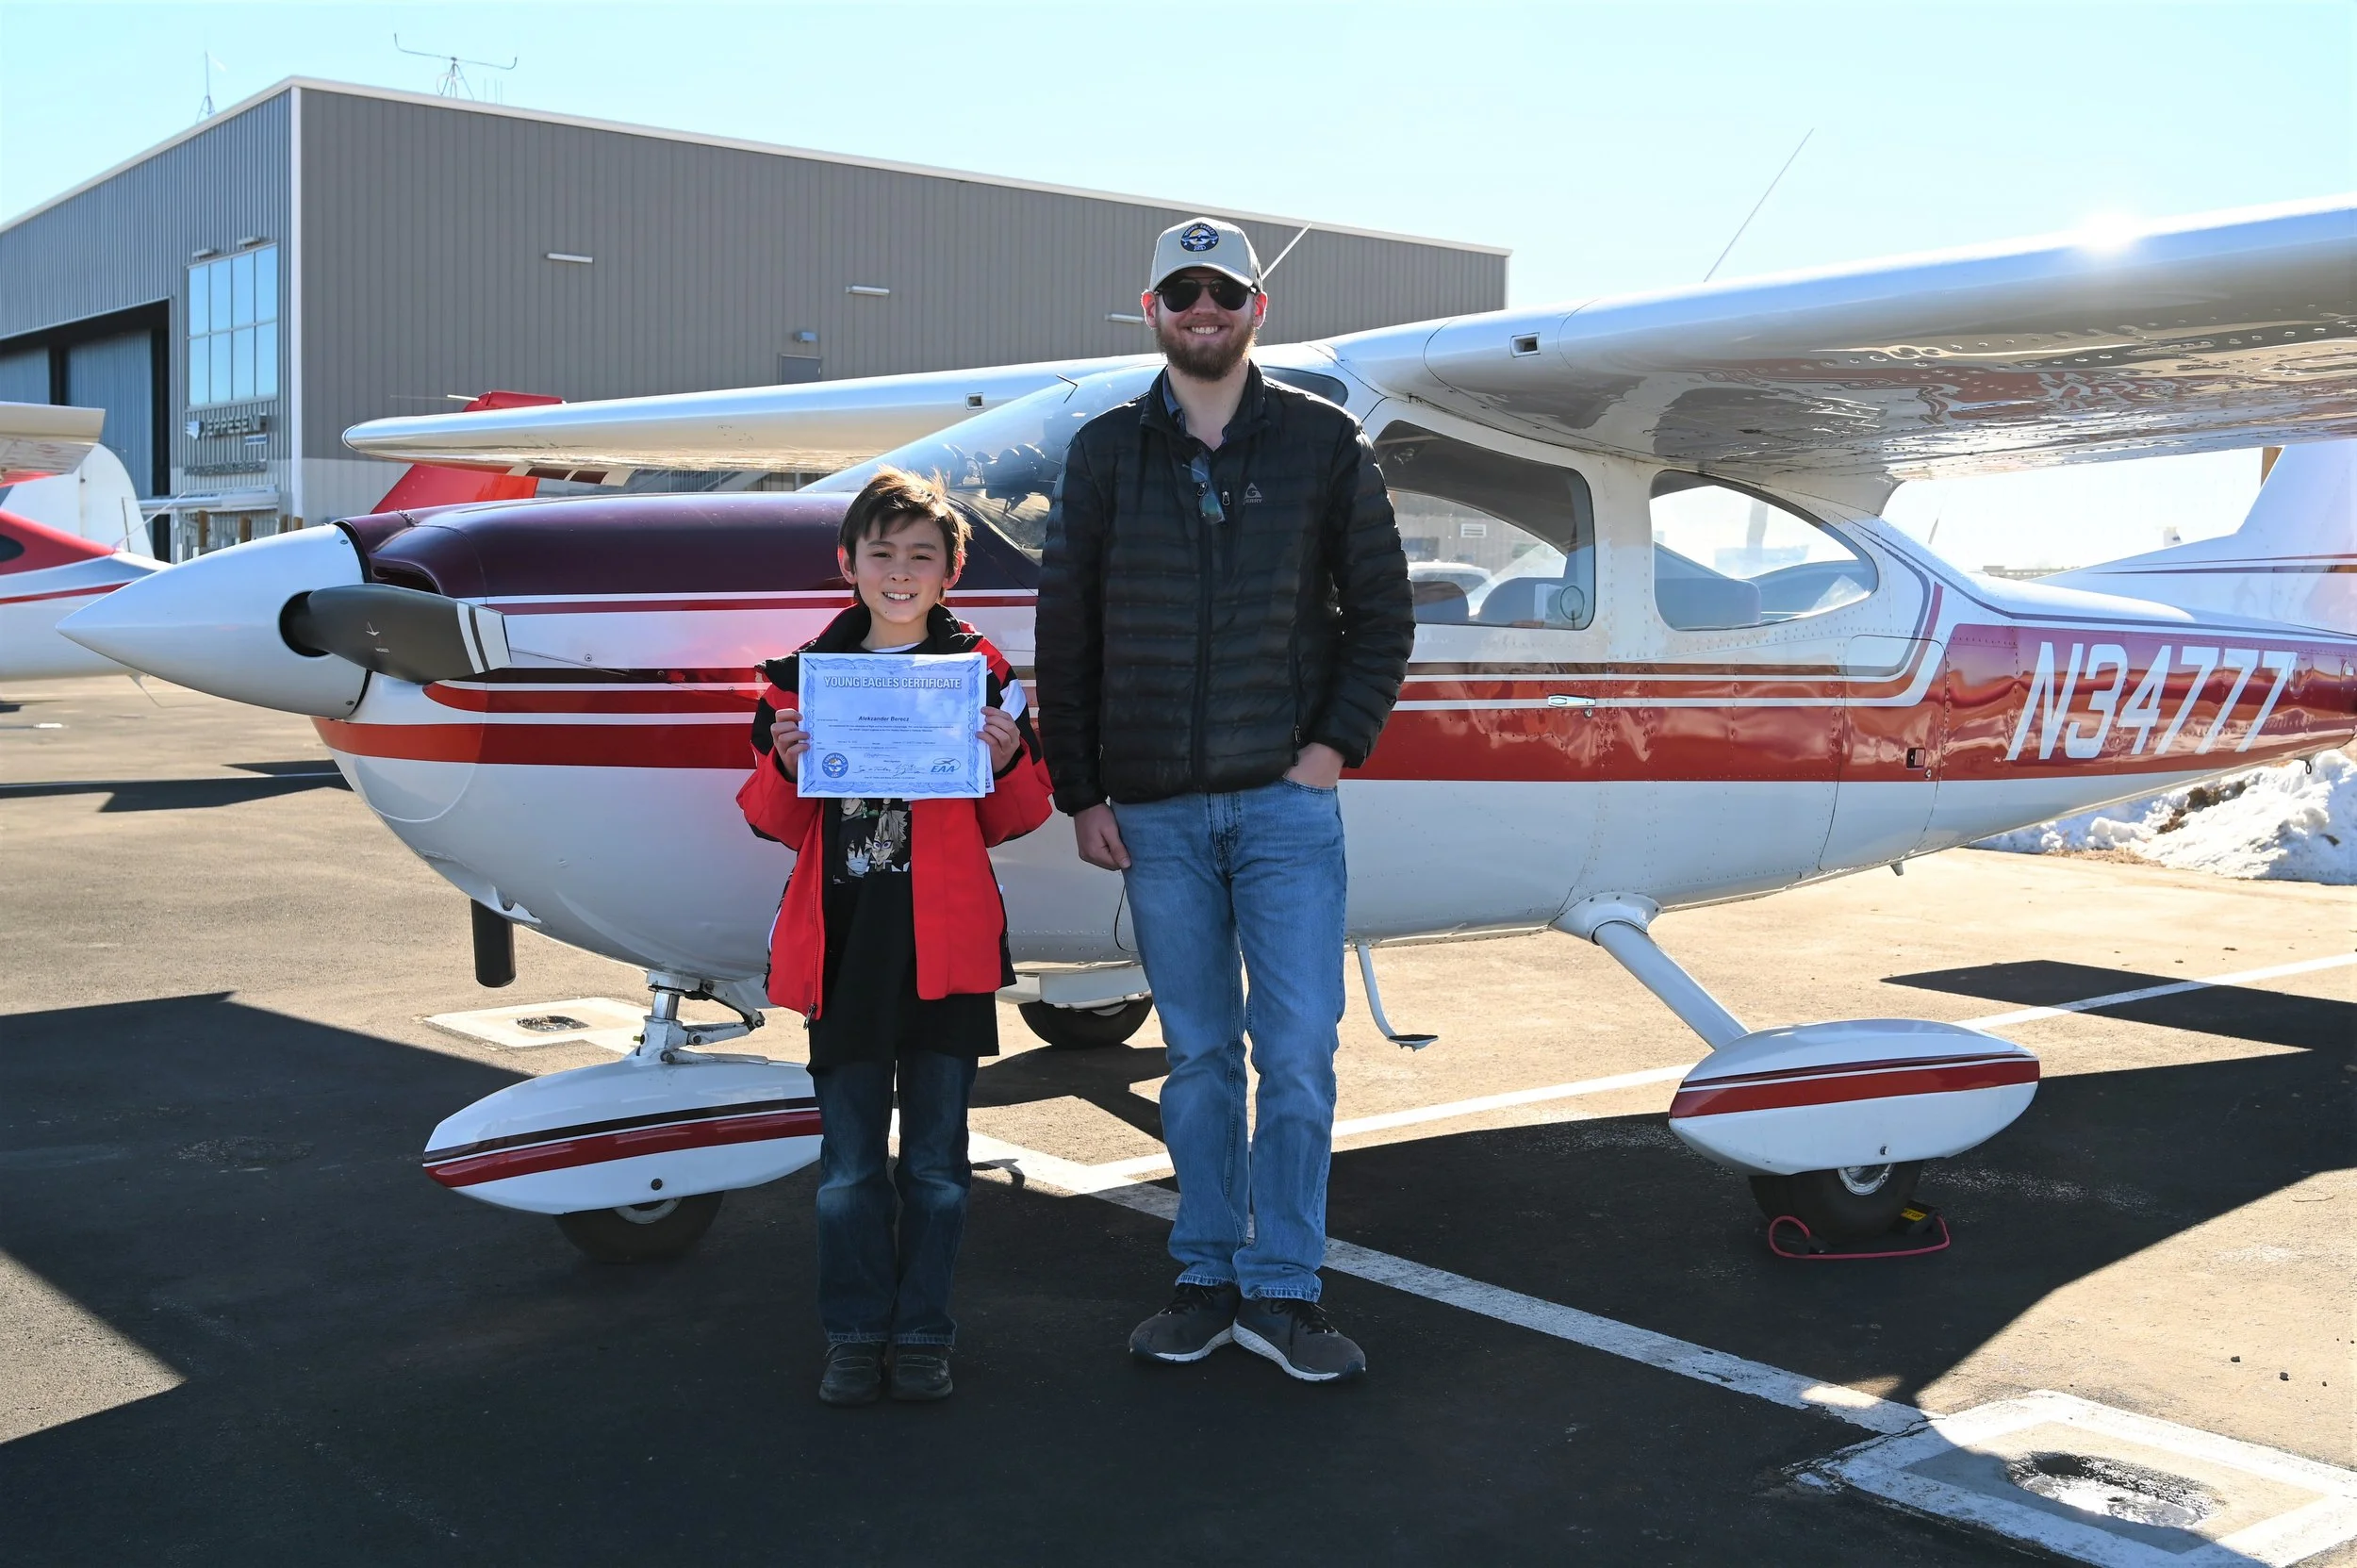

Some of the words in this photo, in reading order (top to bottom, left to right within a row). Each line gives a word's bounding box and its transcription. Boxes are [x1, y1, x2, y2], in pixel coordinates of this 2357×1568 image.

[824, 676, 860, 688] YOUNG
[862, 676, 899, 688] EAGLES
[901, 677, 962, 689] CERTIFICATE
[2004, 641, 2298, 761] N34777
[930, 765, 955, 773] EAA
